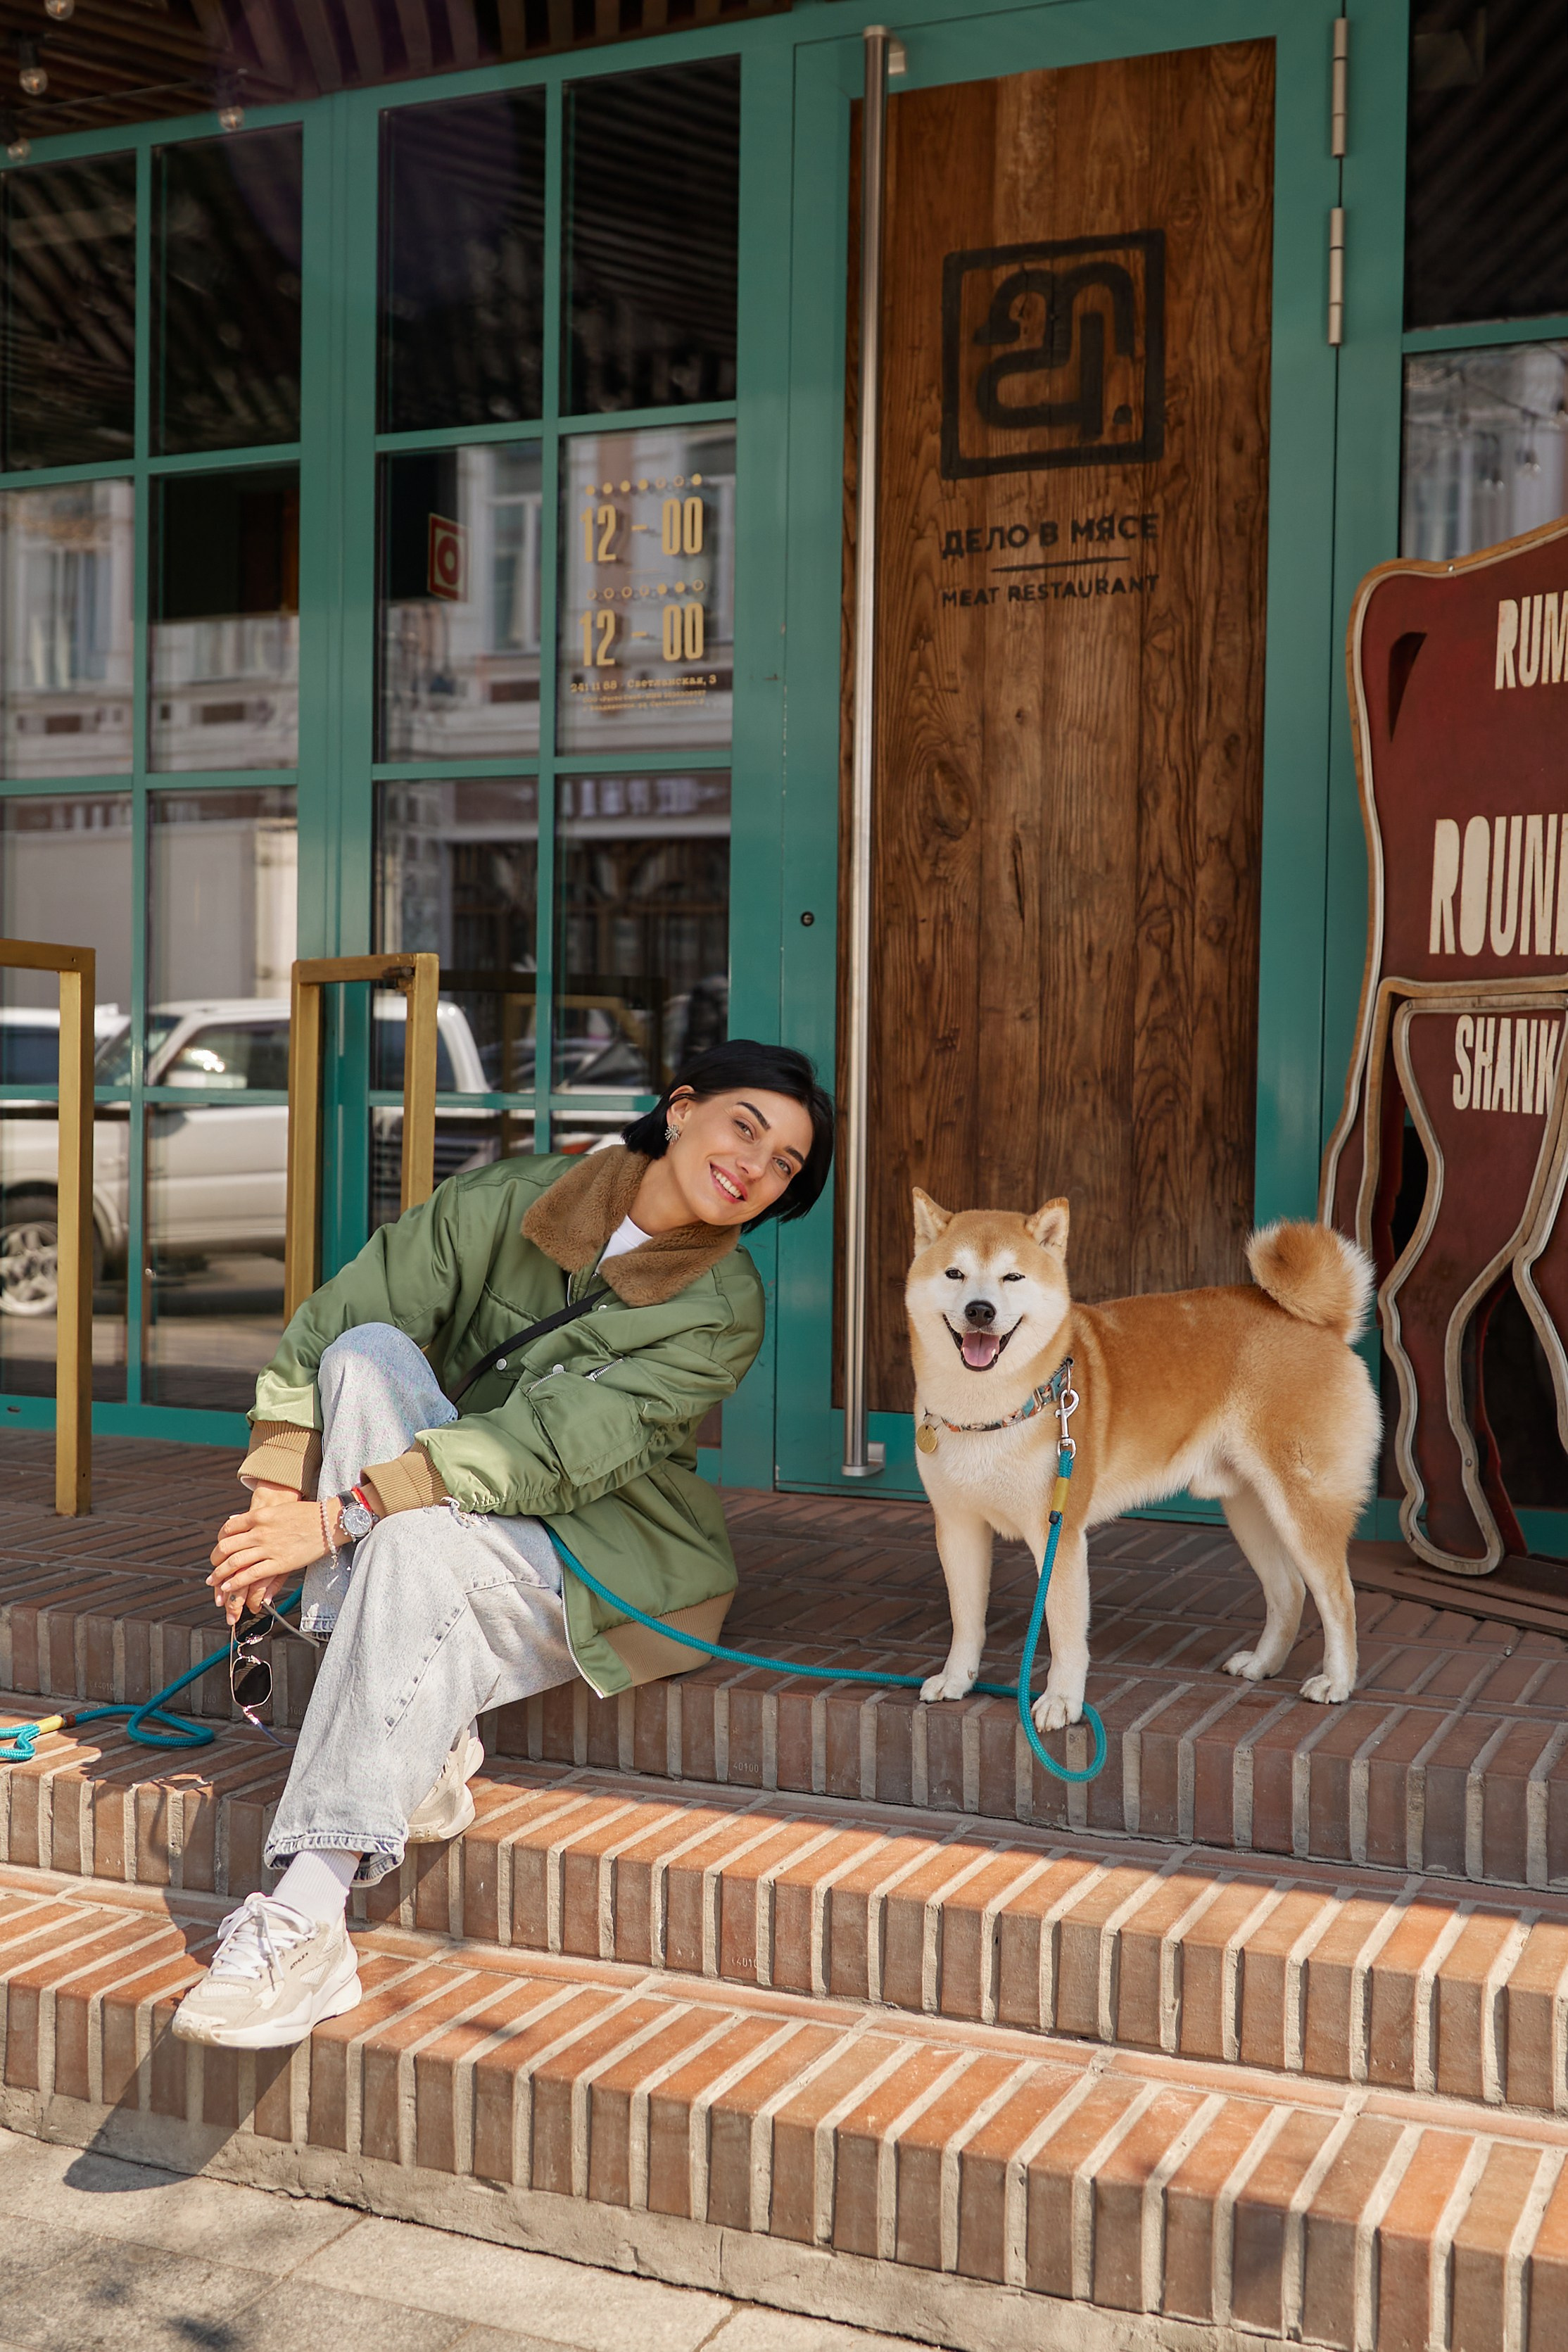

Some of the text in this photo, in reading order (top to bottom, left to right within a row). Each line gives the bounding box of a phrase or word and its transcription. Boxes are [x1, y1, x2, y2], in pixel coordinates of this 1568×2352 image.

[580, 505, 617, 562] 12
[662, 496, 703, 556] 00
[942, 513, 1160, 560] ДЕЛО В МЯСЕ
[942, 574, 1160, 608] MEAT RESTAURANT
[579, 609, 616, 666] 12
[662, 602, 703, 662] 00
[1453, 1014, 1560, 1115] SHANK
